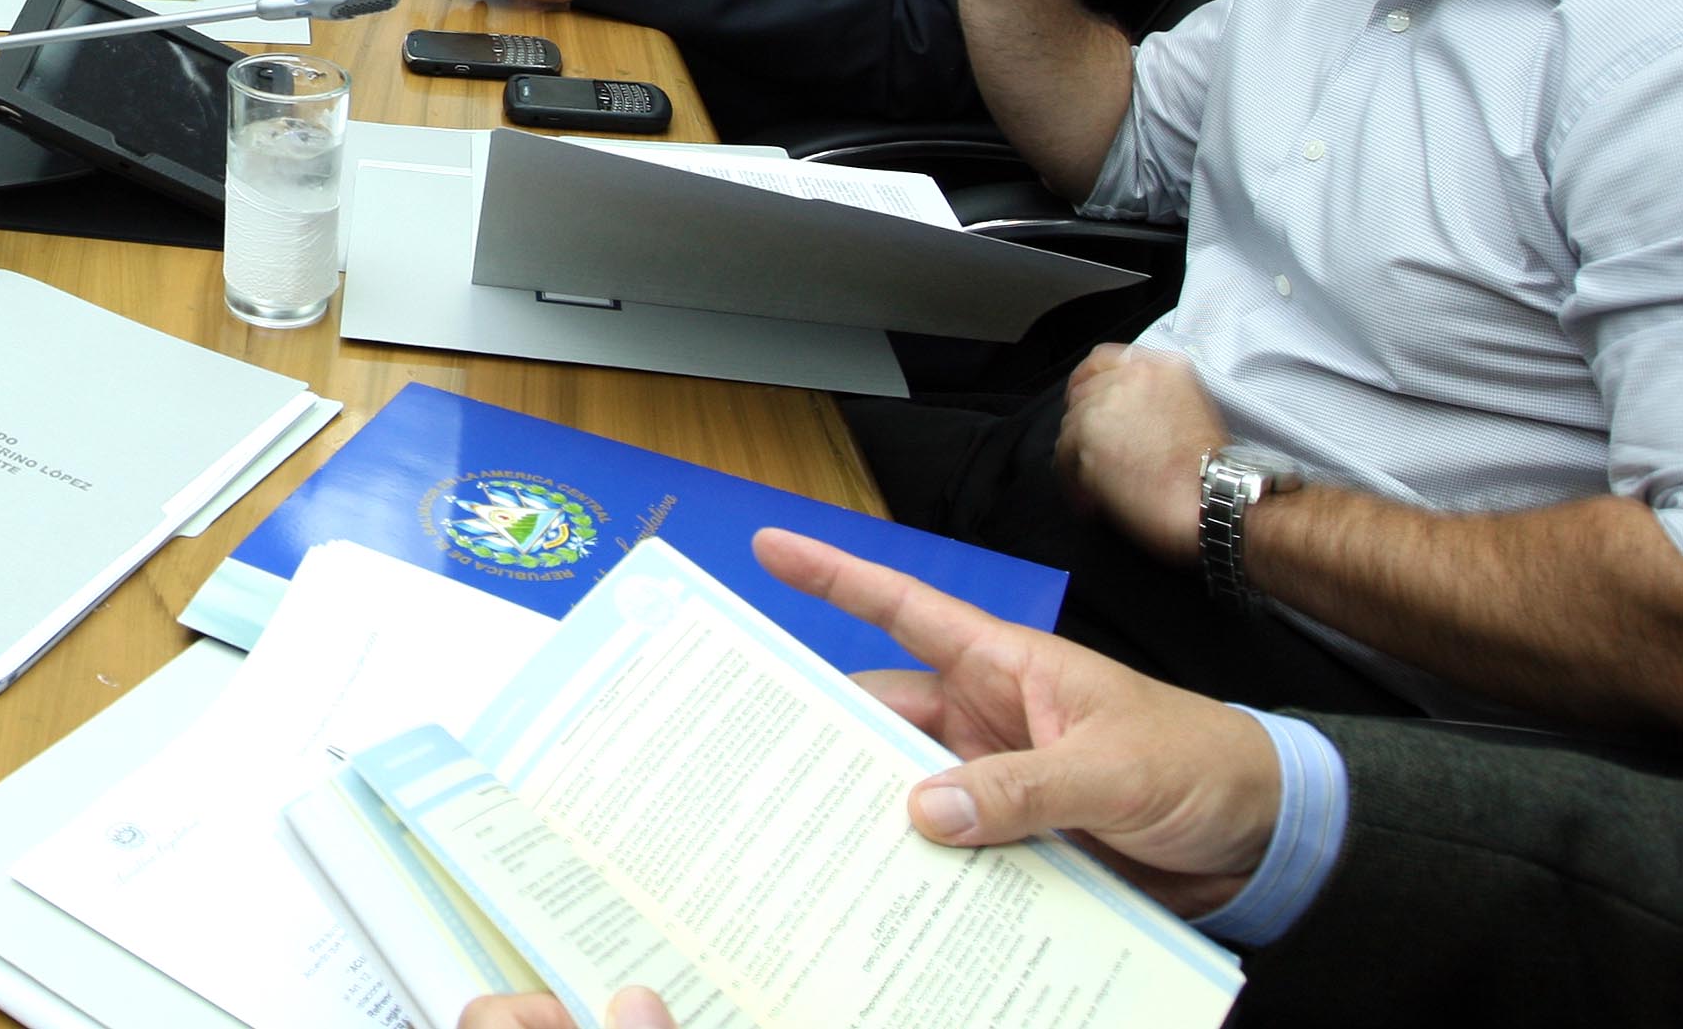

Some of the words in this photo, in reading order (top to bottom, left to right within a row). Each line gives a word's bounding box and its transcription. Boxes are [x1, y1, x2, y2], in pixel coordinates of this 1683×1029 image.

[40, 466, 92, 491] LÓPEZ
[459, 470, 479, 482] LA
[481, 469, 555, 487] AMERICA
[557, 482, 613, 524] CENTRAL
[448, 551, 473, 565] DE
[474, 561, 576, 581] REPUBLICA
